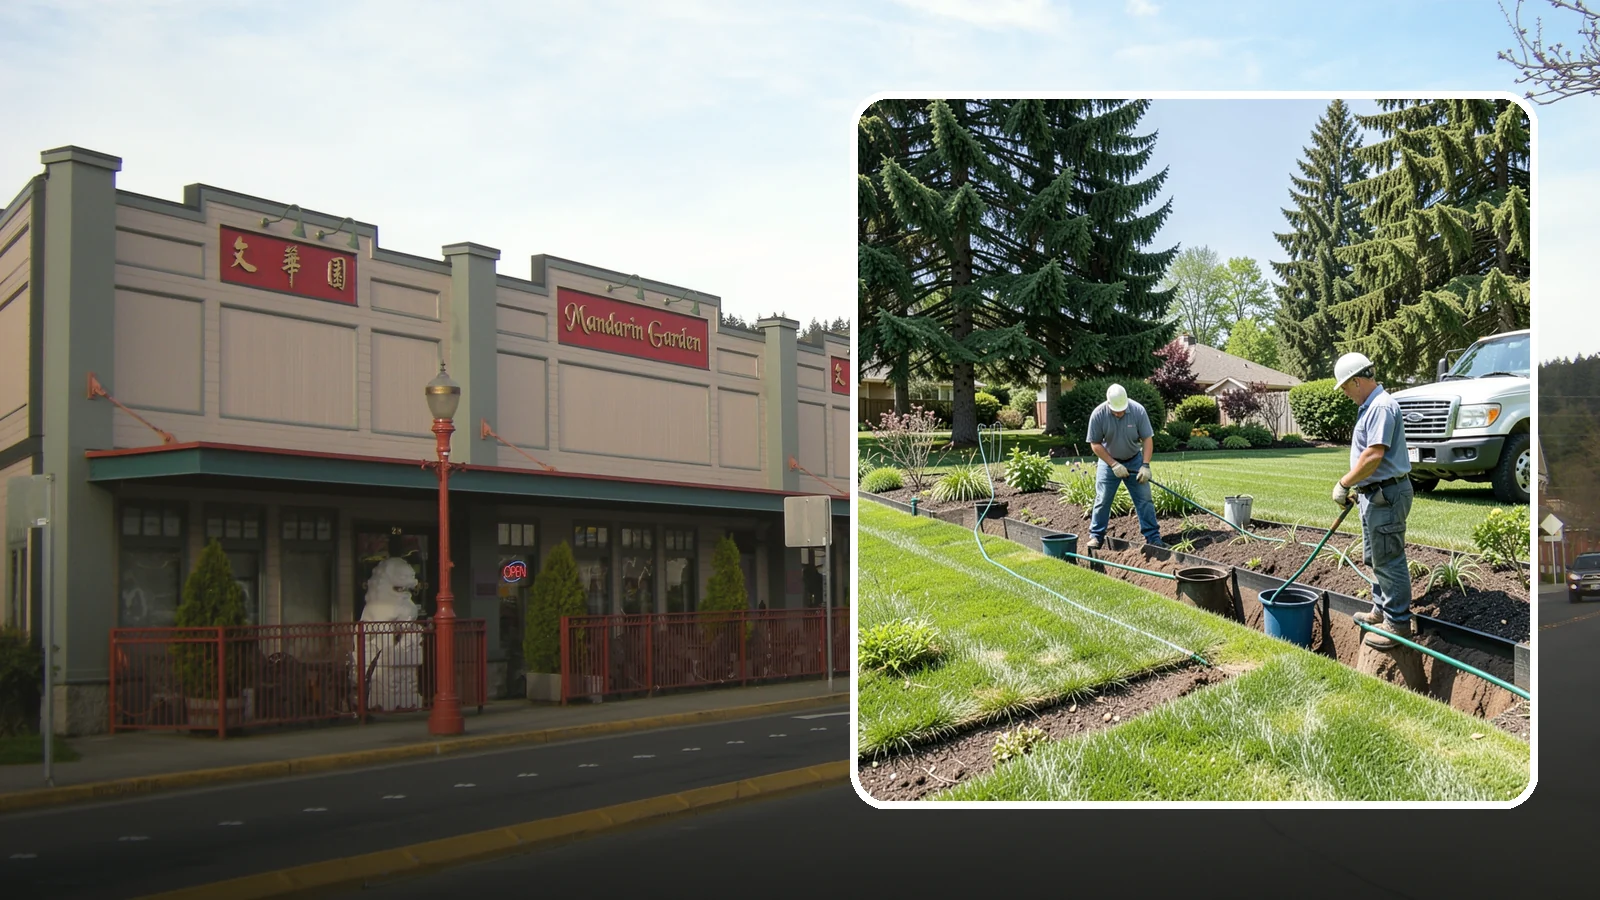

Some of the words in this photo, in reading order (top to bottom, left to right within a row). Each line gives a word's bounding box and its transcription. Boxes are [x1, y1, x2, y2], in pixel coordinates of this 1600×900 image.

[230, 235, 346, 291] 文華園
[564, 302, 644, 341] Mandarin
[647, 320, 701, 352] Garden
[834, 363, 846, 386] 文
[503, 565, 527, 578] OPEN
